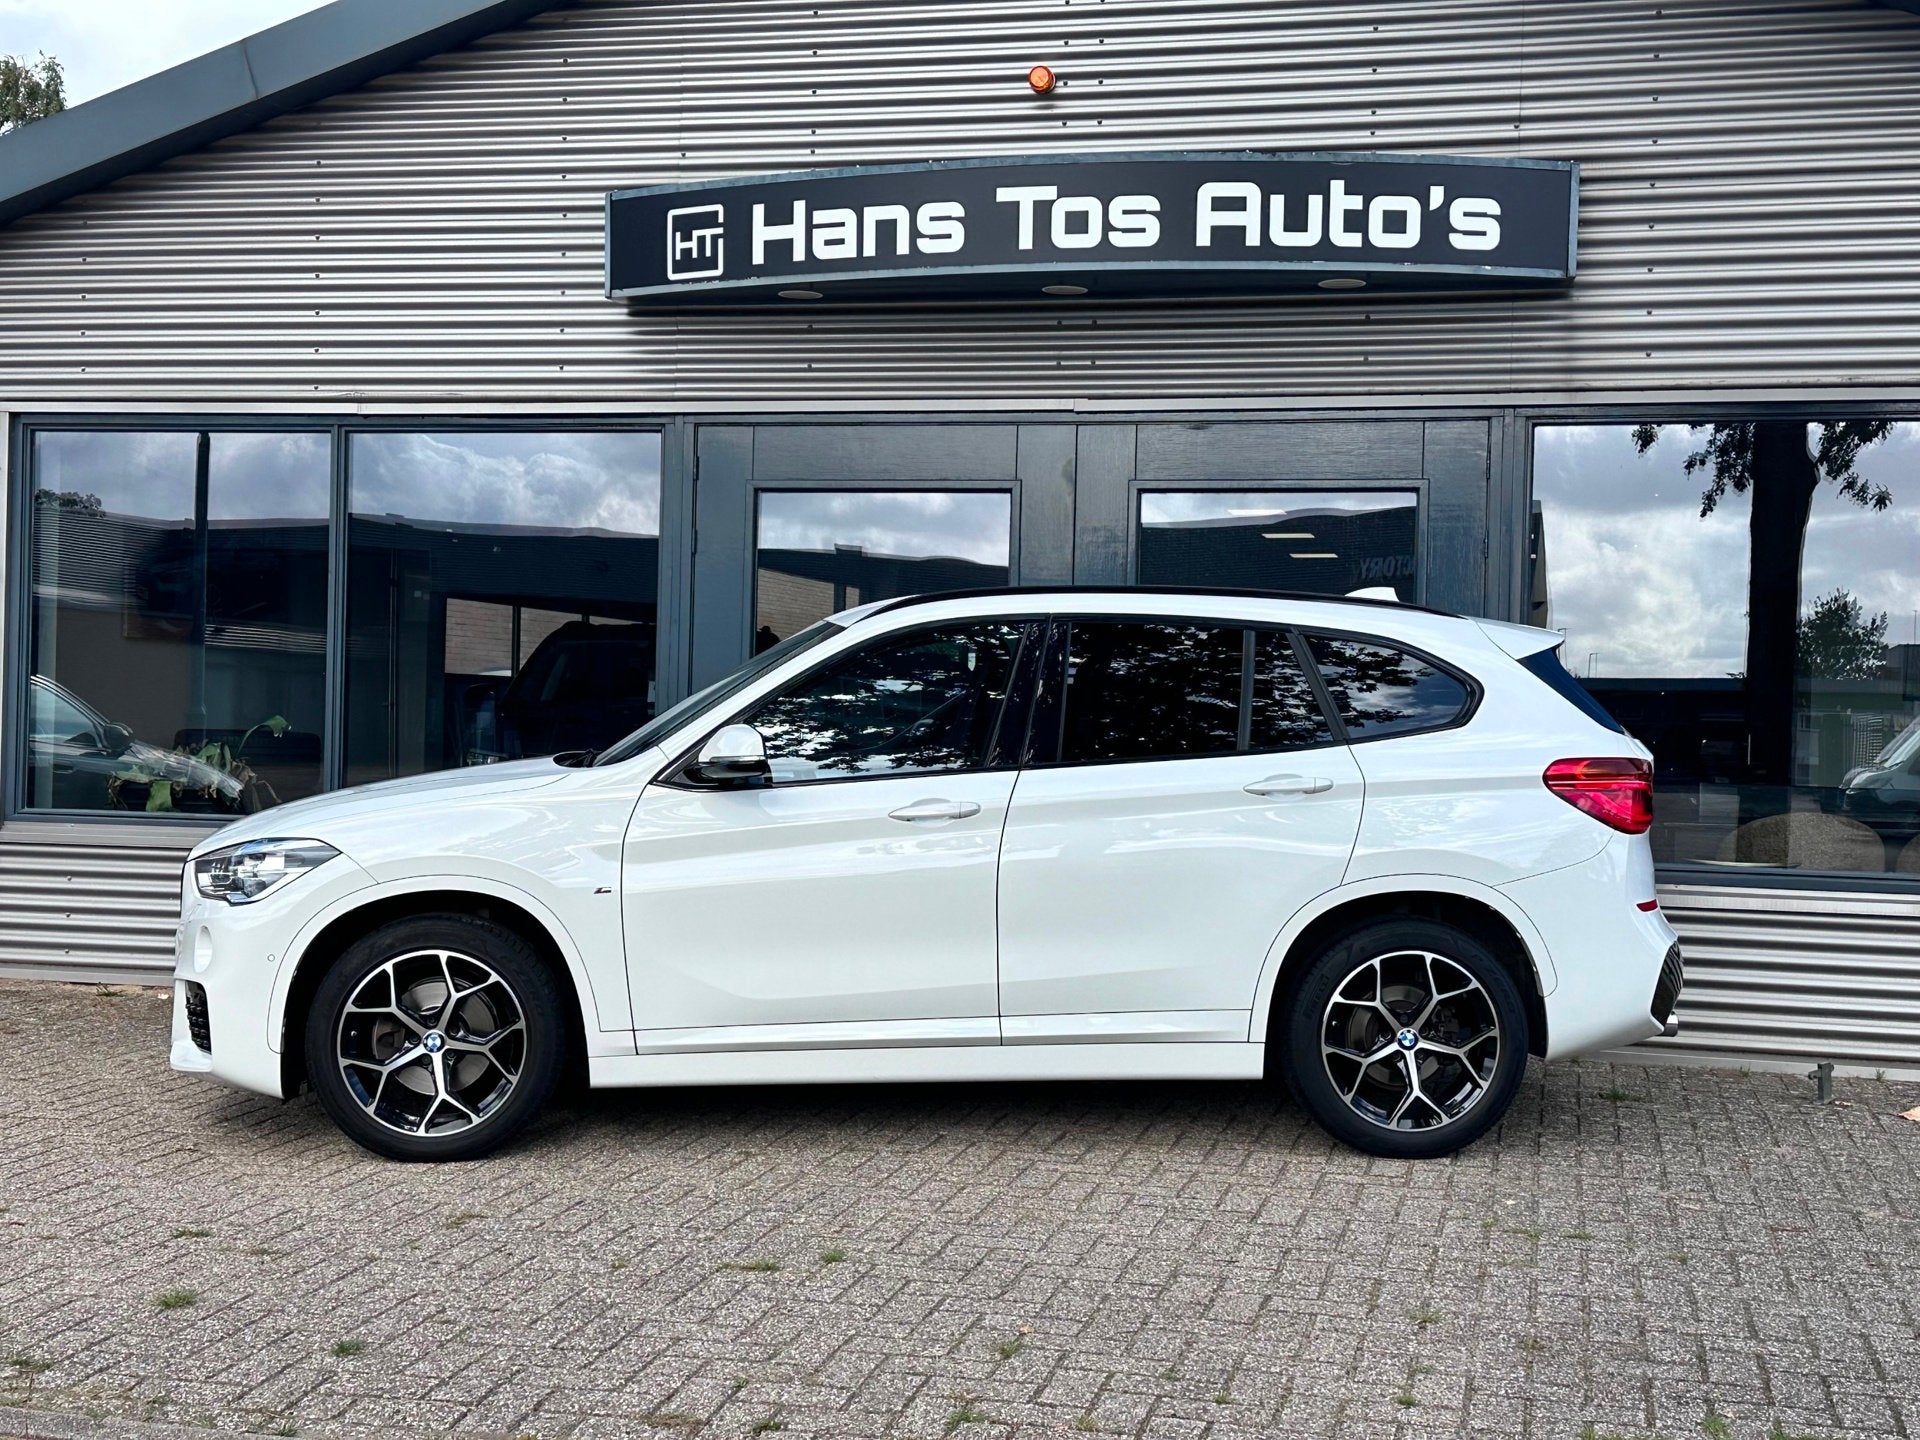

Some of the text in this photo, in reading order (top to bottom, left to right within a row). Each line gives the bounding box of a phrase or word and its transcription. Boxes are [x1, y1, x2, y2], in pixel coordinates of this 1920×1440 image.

[752, 179, 1501, 265] Hans Tos Auto's
